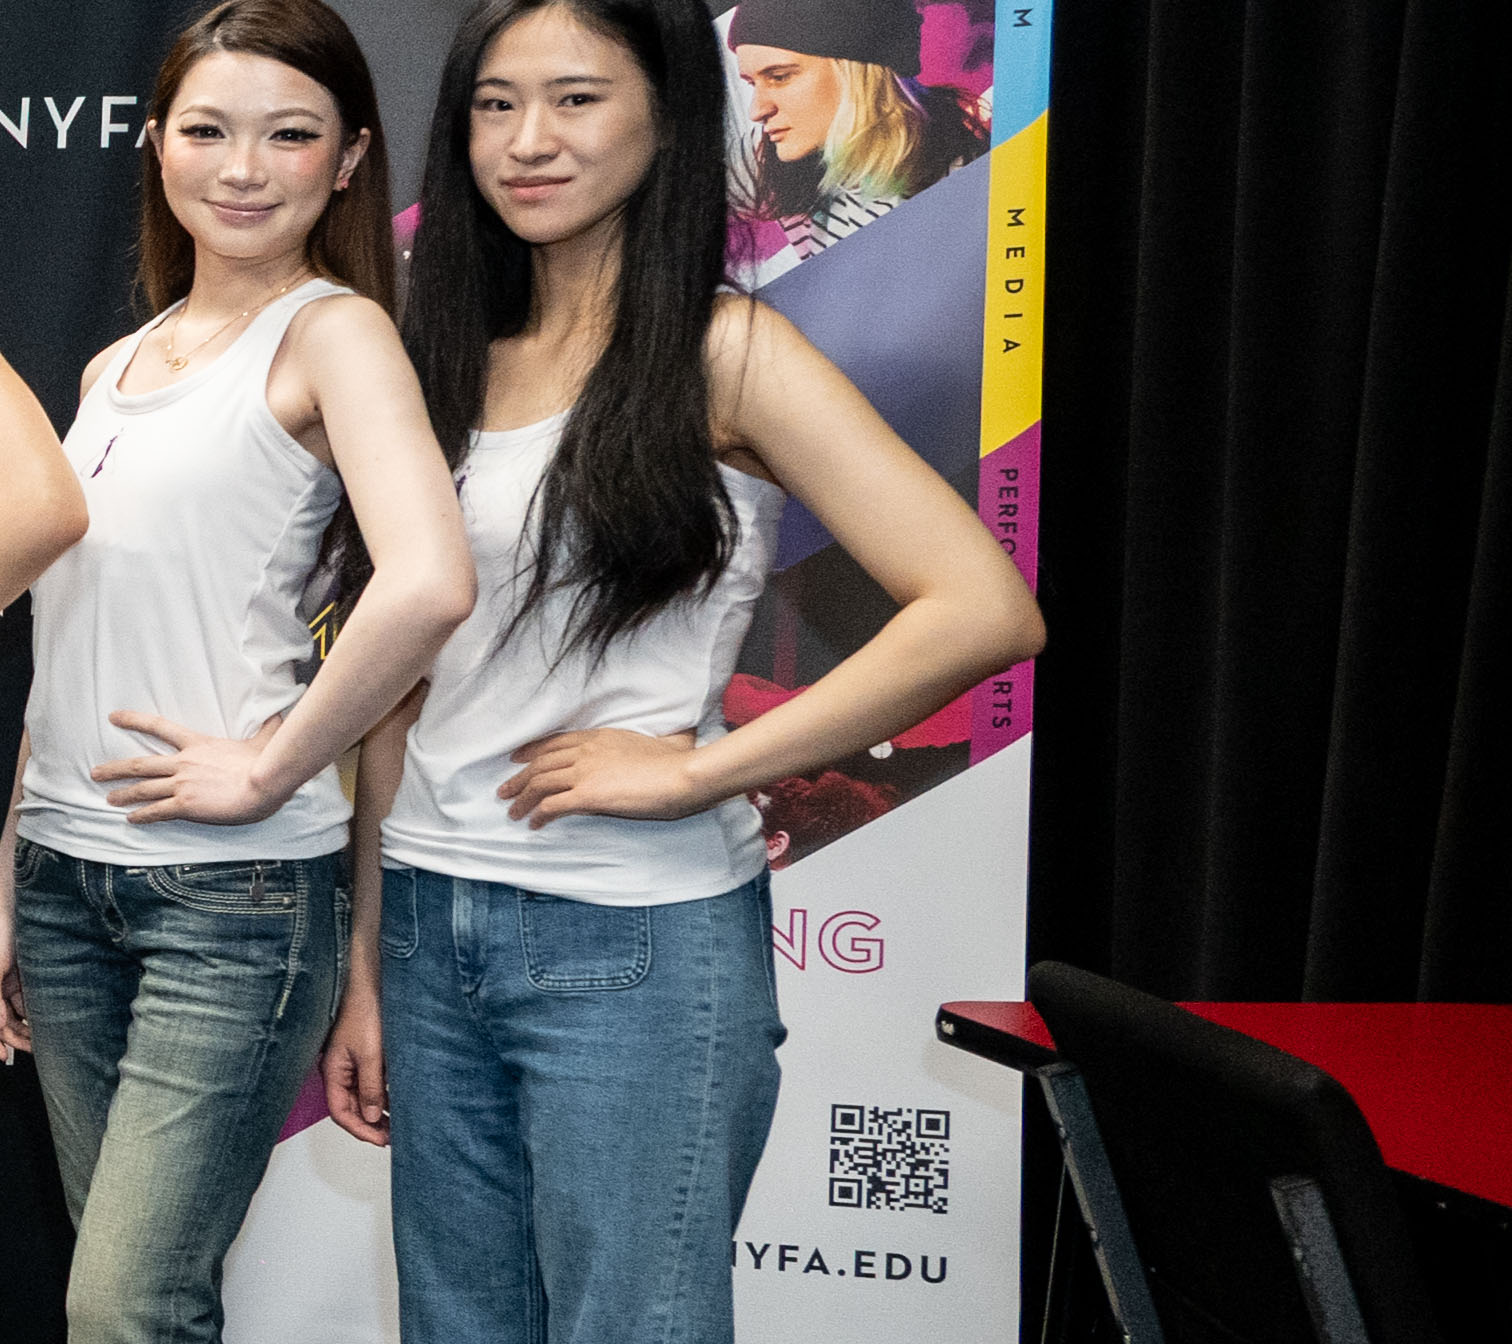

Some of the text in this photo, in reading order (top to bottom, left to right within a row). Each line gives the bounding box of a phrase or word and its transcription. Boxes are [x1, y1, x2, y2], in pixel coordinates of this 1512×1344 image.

[1002, 207, 1027, 354] MEDIA
[992, 680, 1013, 730] RTS
[731, 1239, 949, 1285] YFA.EDU
